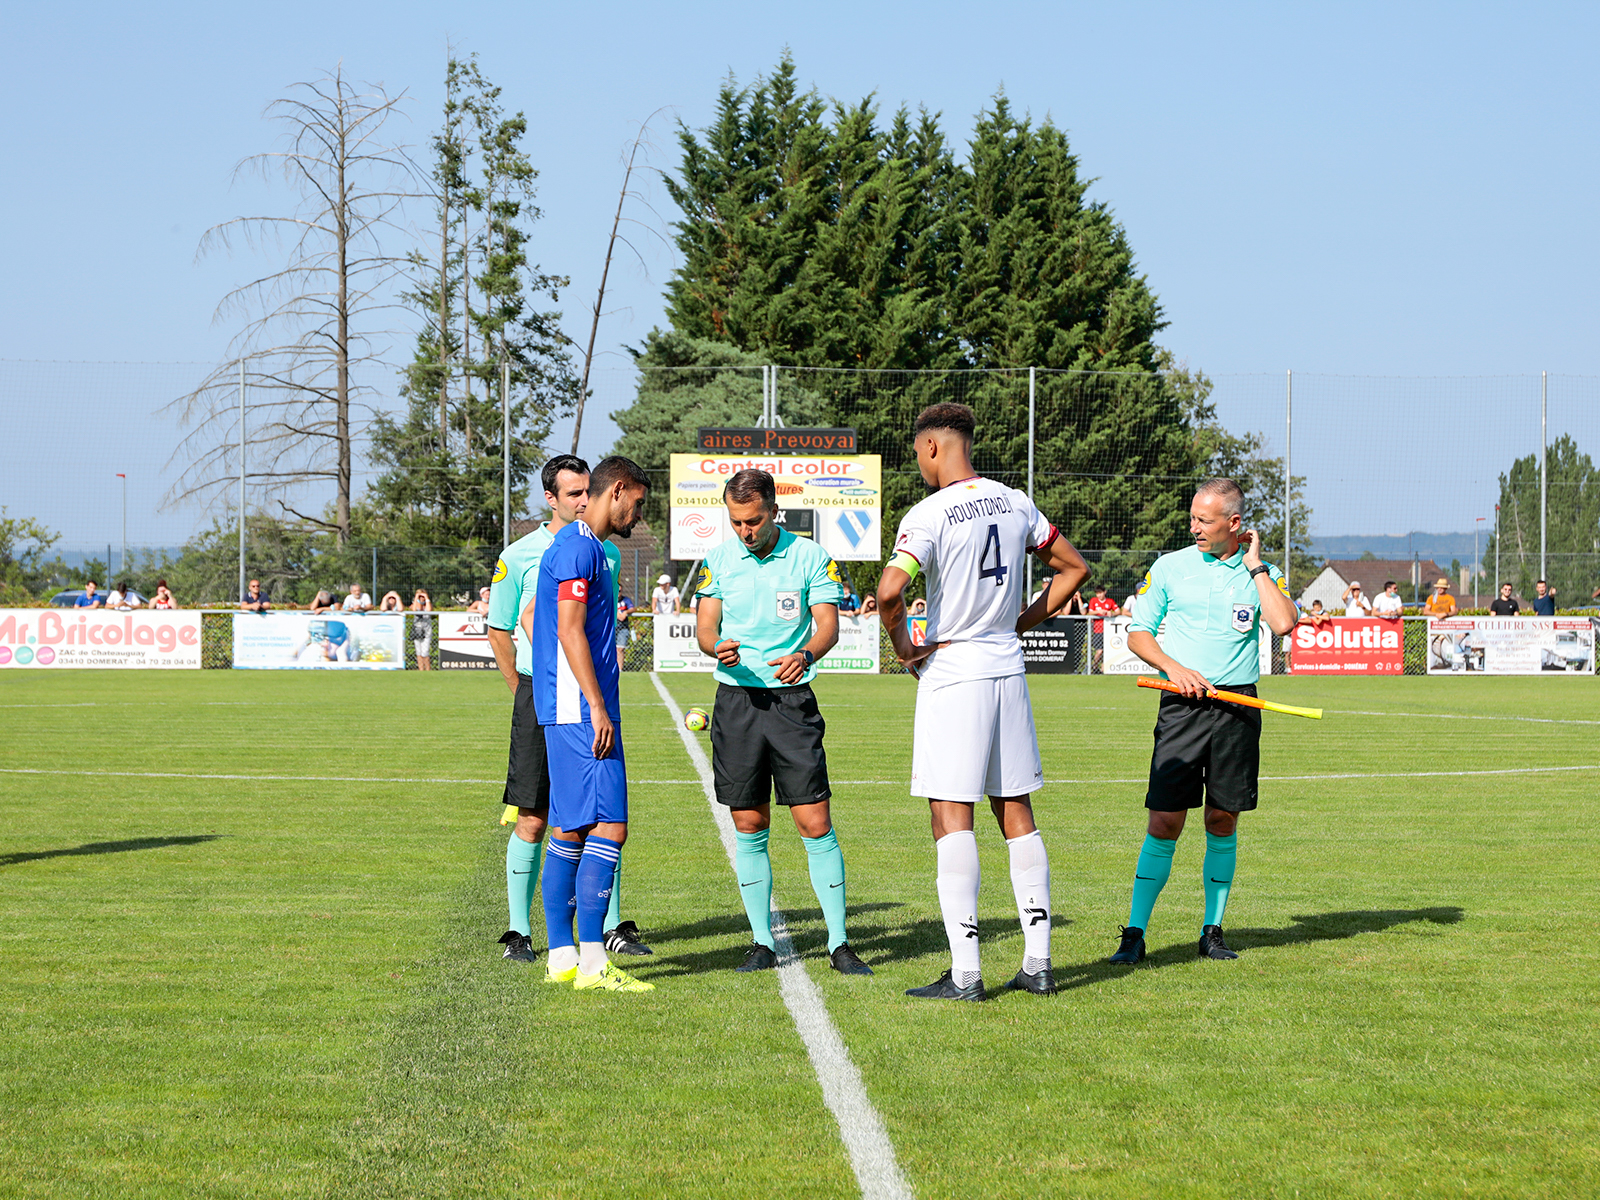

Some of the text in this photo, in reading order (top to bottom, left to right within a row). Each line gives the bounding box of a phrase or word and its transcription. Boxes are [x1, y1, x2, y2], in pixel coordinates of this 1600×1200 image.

[700, 431, 752, 448] aires
[700, 459, 851, 475] Central color
[776, 484, 804, 495] tures
[676, 497, 709, 505] 03410
[802, 498, 874, 506] 04 70 64 14 60
[979, 523, 1008, 587] 4
[571, 580, 585, 598] C
[1477, 621, 1527, 630] CELLIERE
[1532, 621, 1550, 630] SAS
[1296, 625, 1398, 648] Solutia
[823, 660, 871, 668] 09 83 77 04 52
